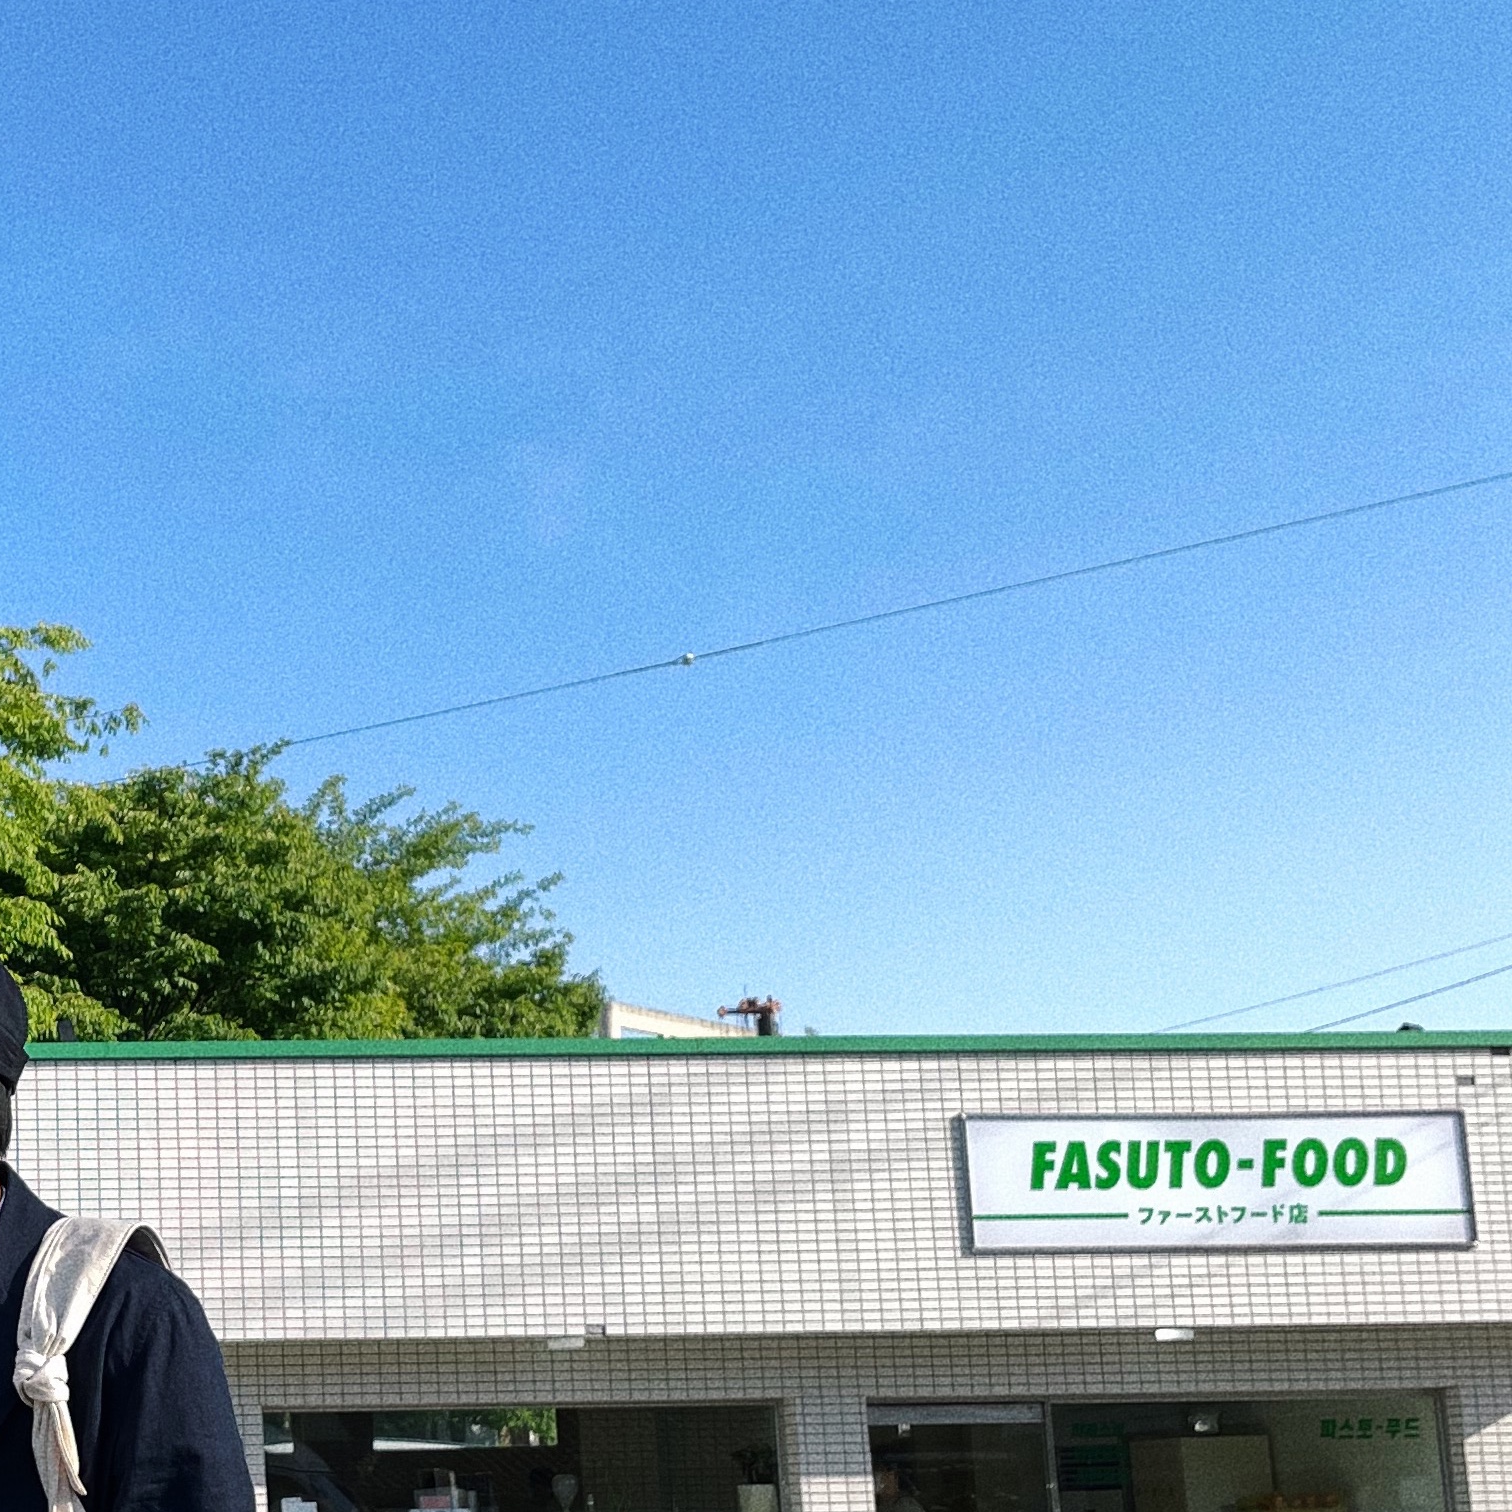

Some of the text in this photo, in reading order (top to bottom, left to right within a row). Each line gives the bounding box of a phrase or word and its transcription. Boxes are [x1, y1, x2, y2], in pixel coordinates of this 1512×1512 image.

[1029, 1137, 1407, 1191] FASUTO-FOOD
[1138, 1203, 1309, 1225] ファーストフード店
